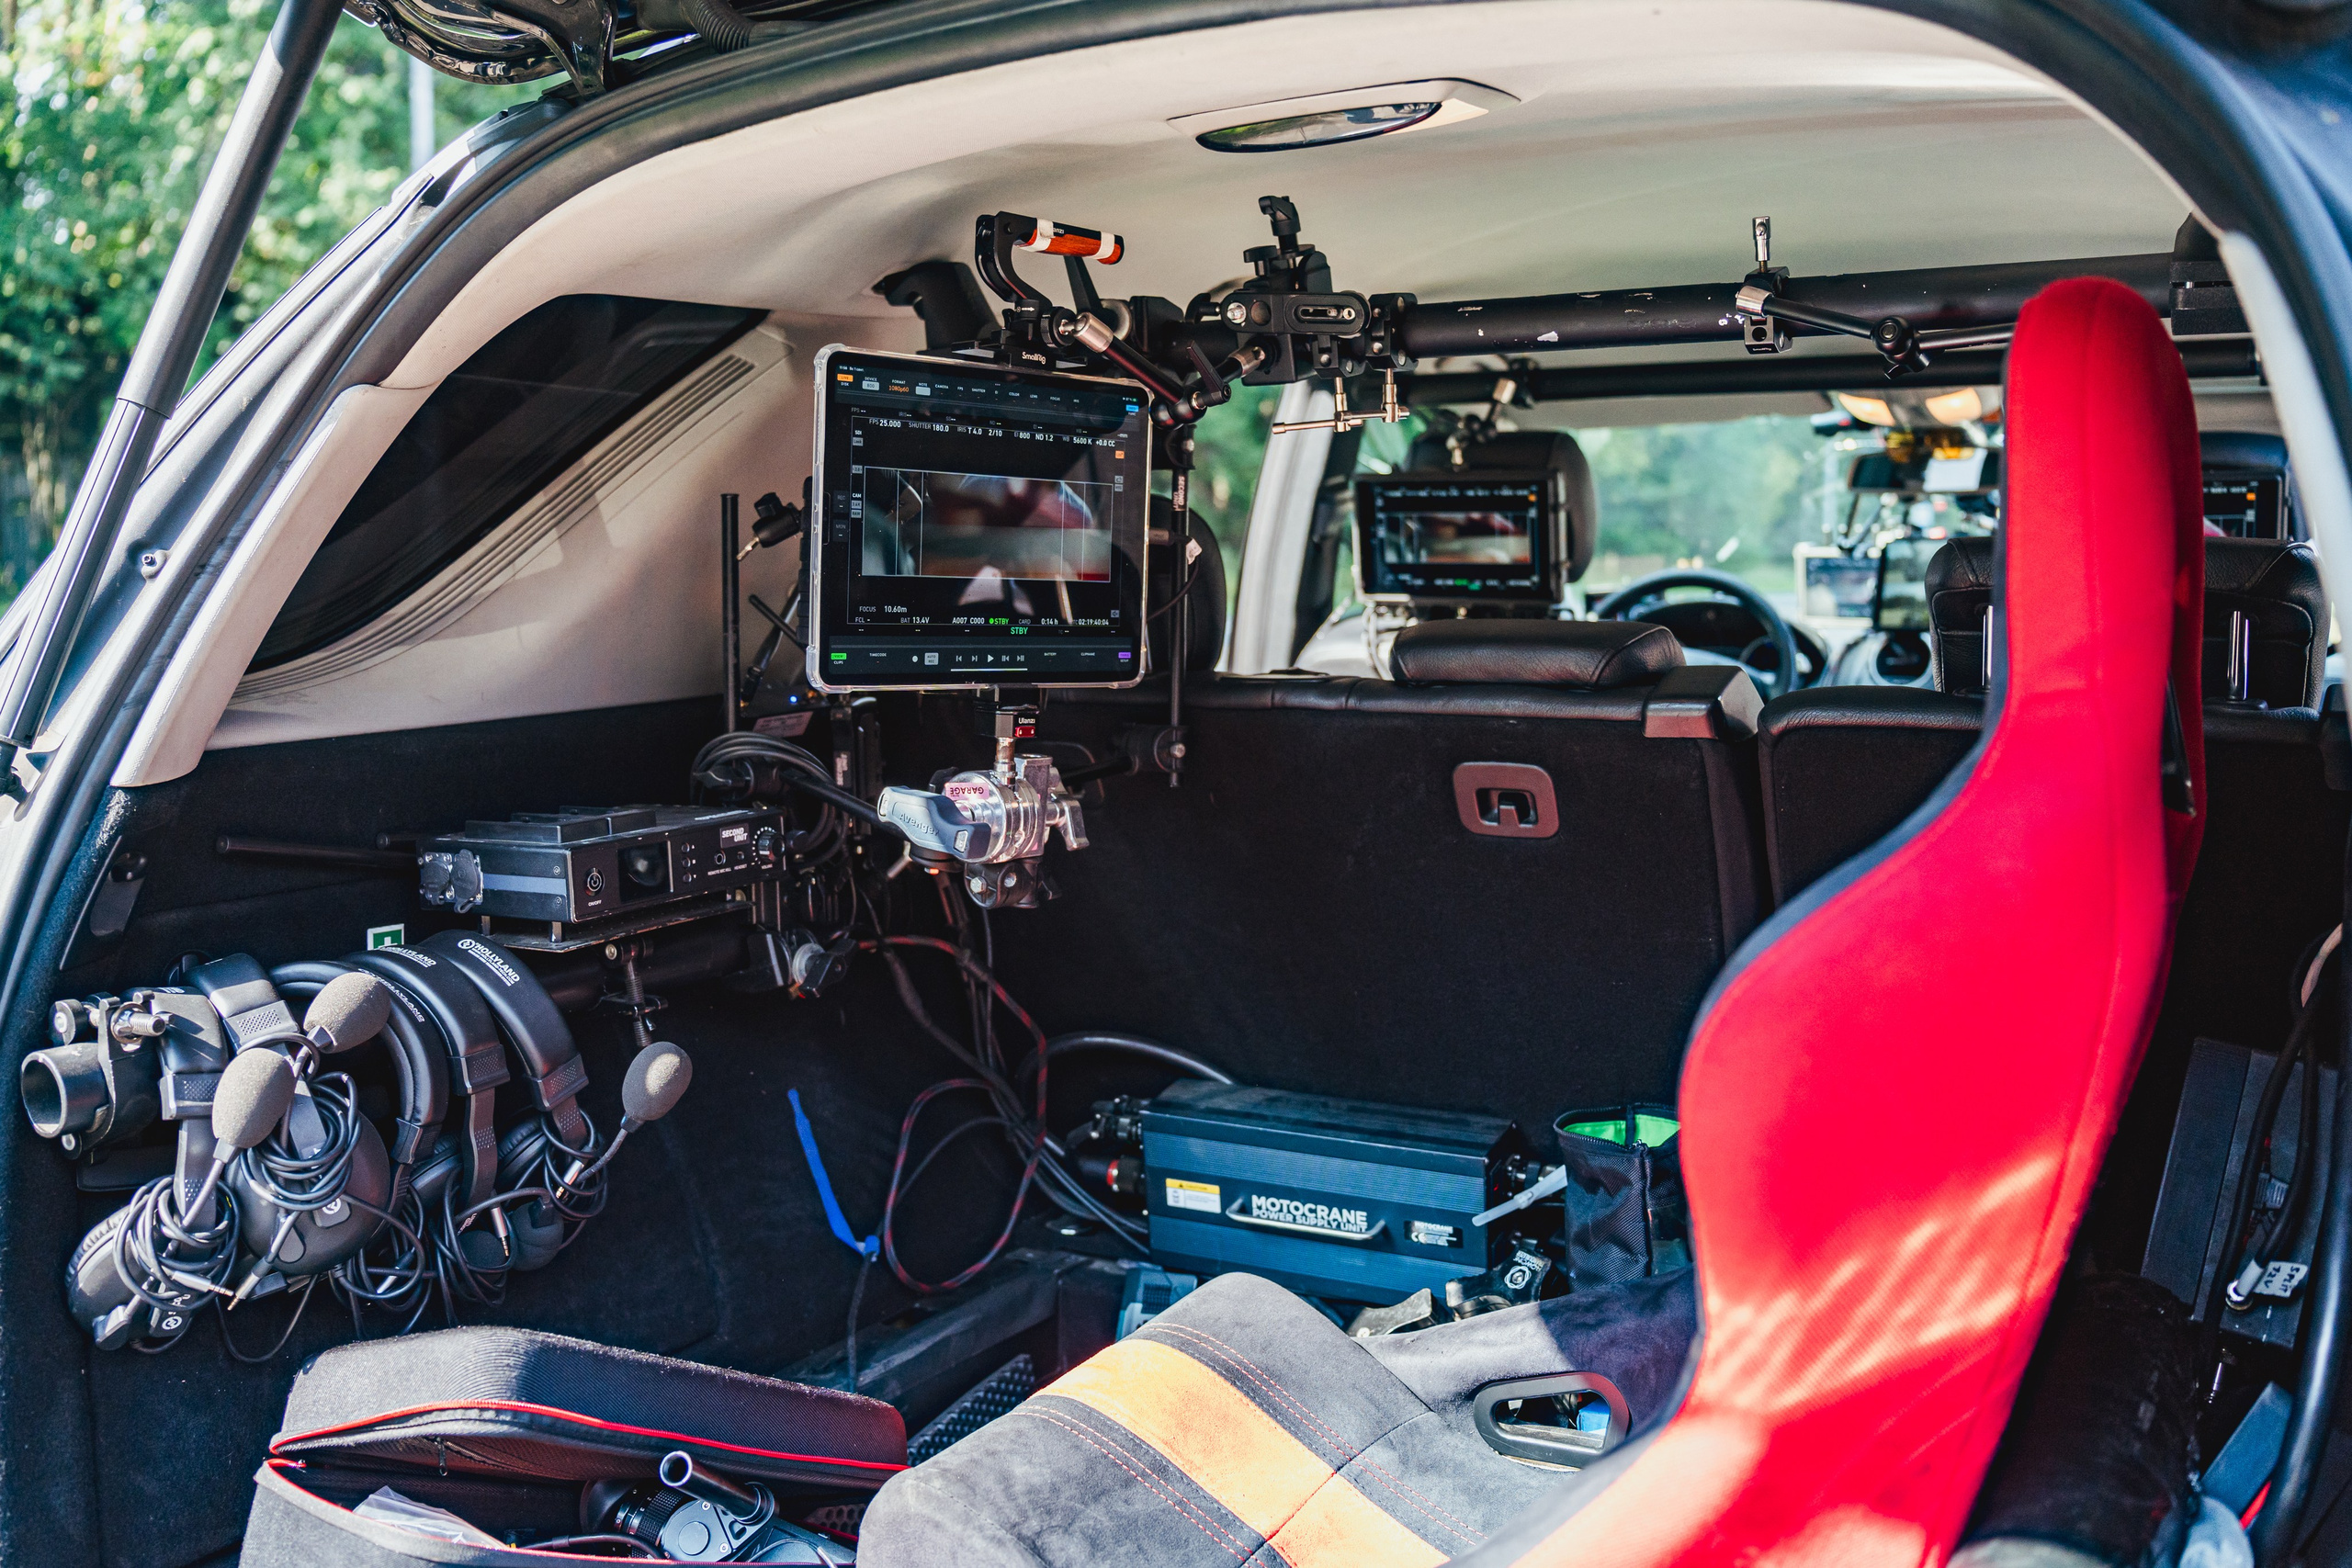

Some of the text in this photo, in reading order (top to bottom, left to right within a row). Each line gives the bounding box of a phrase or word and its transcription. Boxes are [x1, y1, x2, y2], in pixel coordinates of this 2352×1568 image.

[1022, 351, 1046, 365] SmallRig
[879, 419, 901, 428] 25.000
[933, 424, 949, 433] 180.0
[988, 429, 1002, 437] 2/10
[1072, 436, 1087, 445] 5600
[884, 605, 908, 614] 10.60m
[1011, 626, 1028, 635] STBY
[949, 786, 984, 795] GARAGE
[899, 813, 939, 836] Avenger
[721, 827, 744, 839] SECOND
[734, 832, 748, 842] UNIT
[474, 942, 520, 982] HOLLYLAND
[1251, 1194, 1367, 1224] MOTOCRANE
[1252, 1208, 1368, 1233] POWER SUPPLY UNIT
